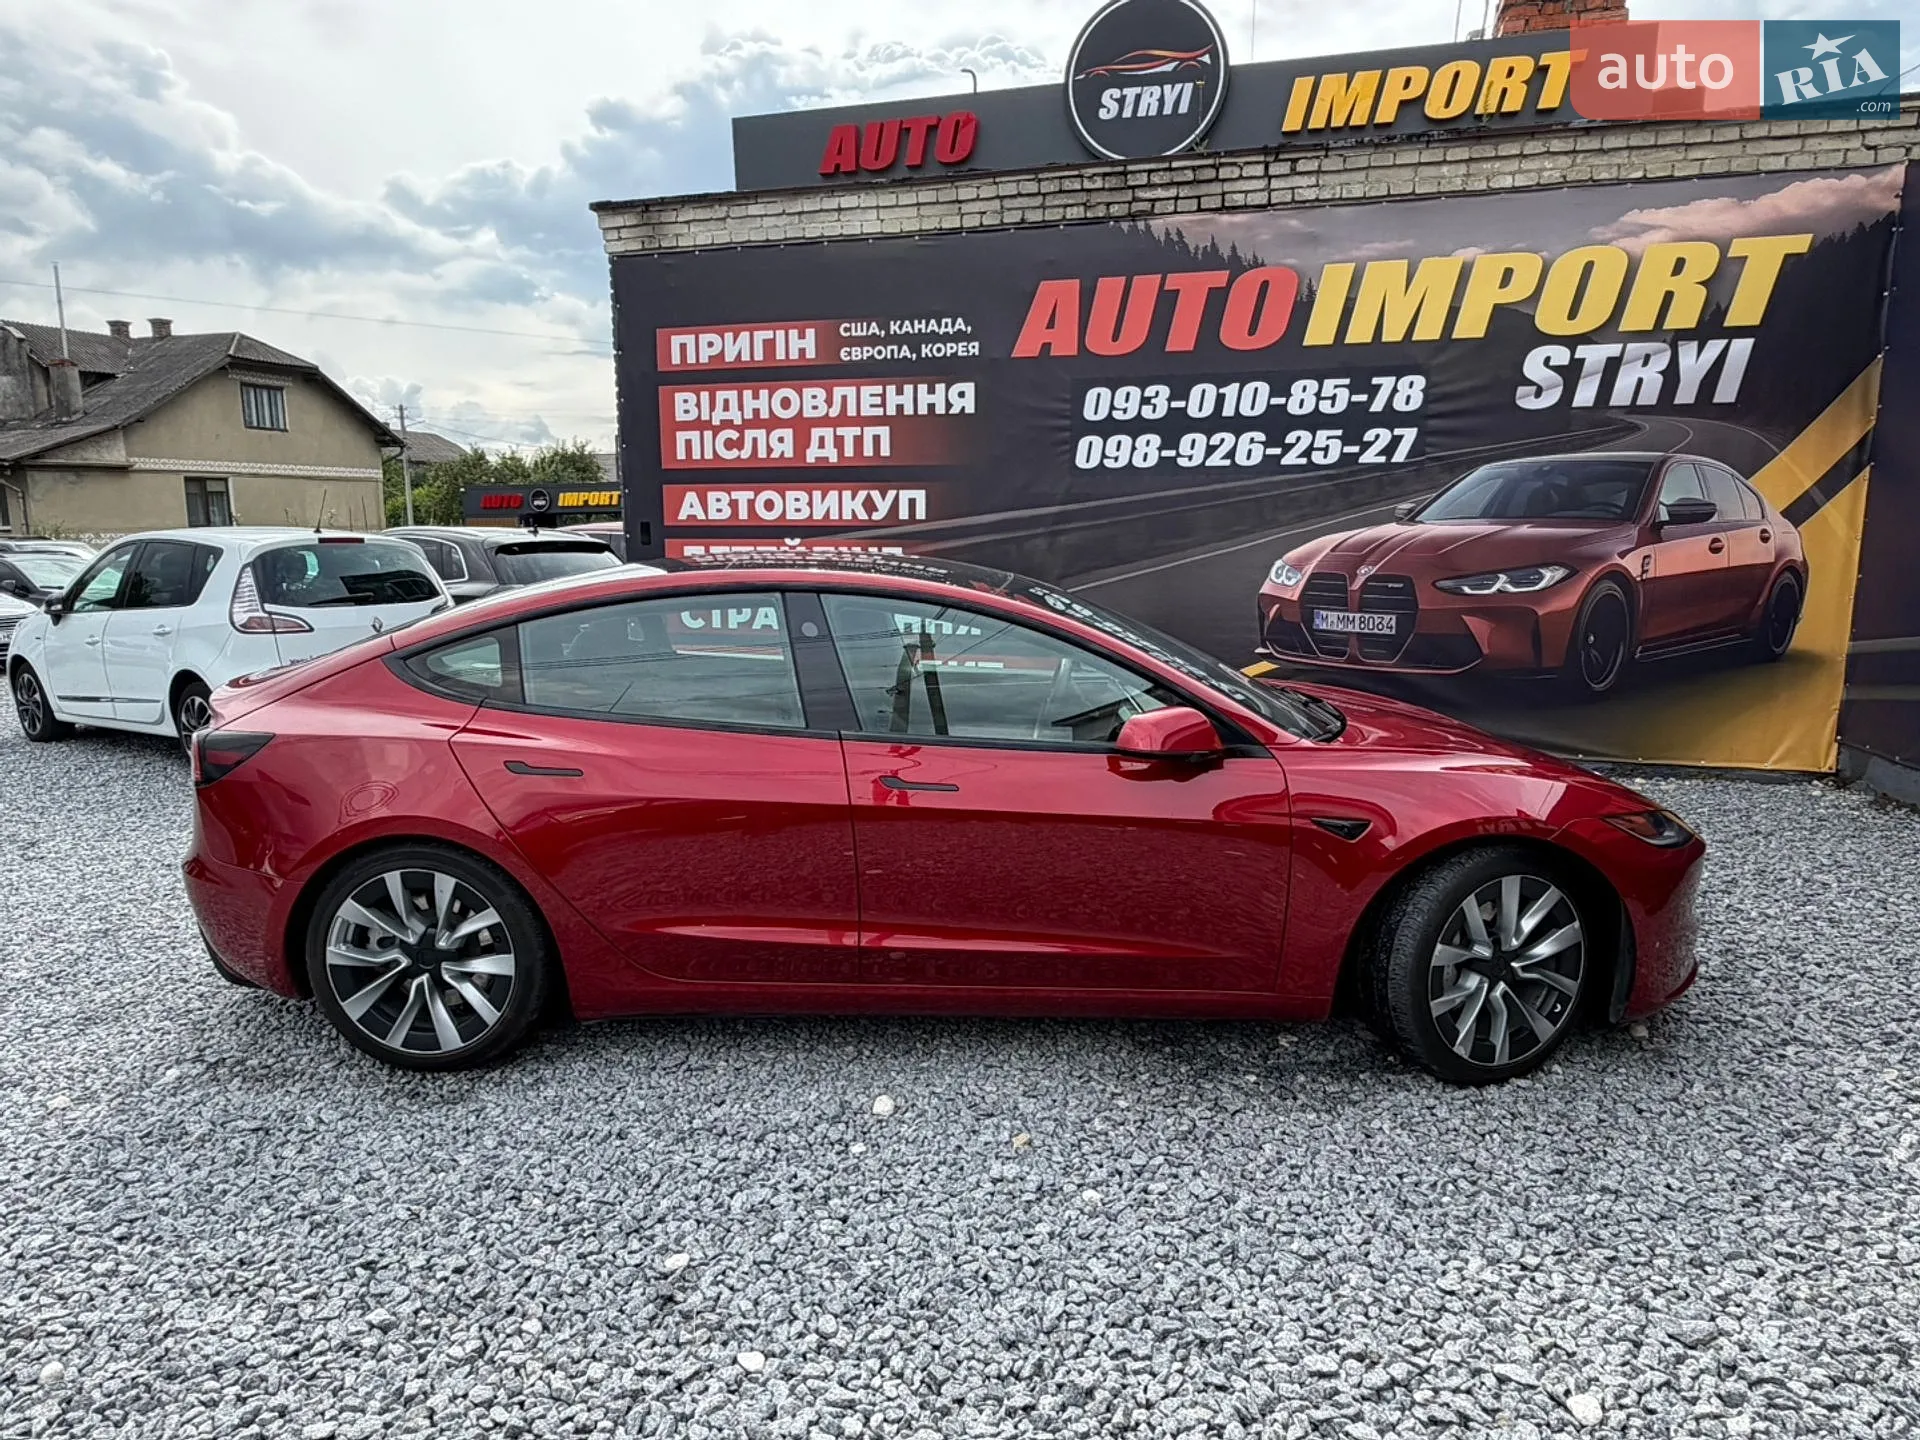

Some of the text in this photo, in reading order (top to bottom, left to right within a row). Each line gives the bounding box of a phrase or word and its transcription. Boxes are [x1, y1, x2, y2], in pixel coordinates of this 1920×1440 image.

[818, 49, 1588, 175] AUTO IMPORT
[1098, 82, 1194, 120] STRYI
[670, 328, 816, 366] ПРИГІН
[839, 317, 972, 339] США, КАНАДА,
[839, 341, 980, 362] ЄВРОПА, КОРЕЯ
[1515, 337, 1755, 411] STRYI
[674, 382, 975, 425] ВІДНОВЛЕННЯ
[1083, 374, 1426, 421] 093-010-85-78
[675, 426, 891, 464] ПІСЛЯ ДТП
[1074, 427, 1418, 469] 098-926-25-27
[481, 493, 522, 508] AUTO
[558, 491, 621, 507] IMPORT
[677, 489, 926, 521] АВТОВИКУП
